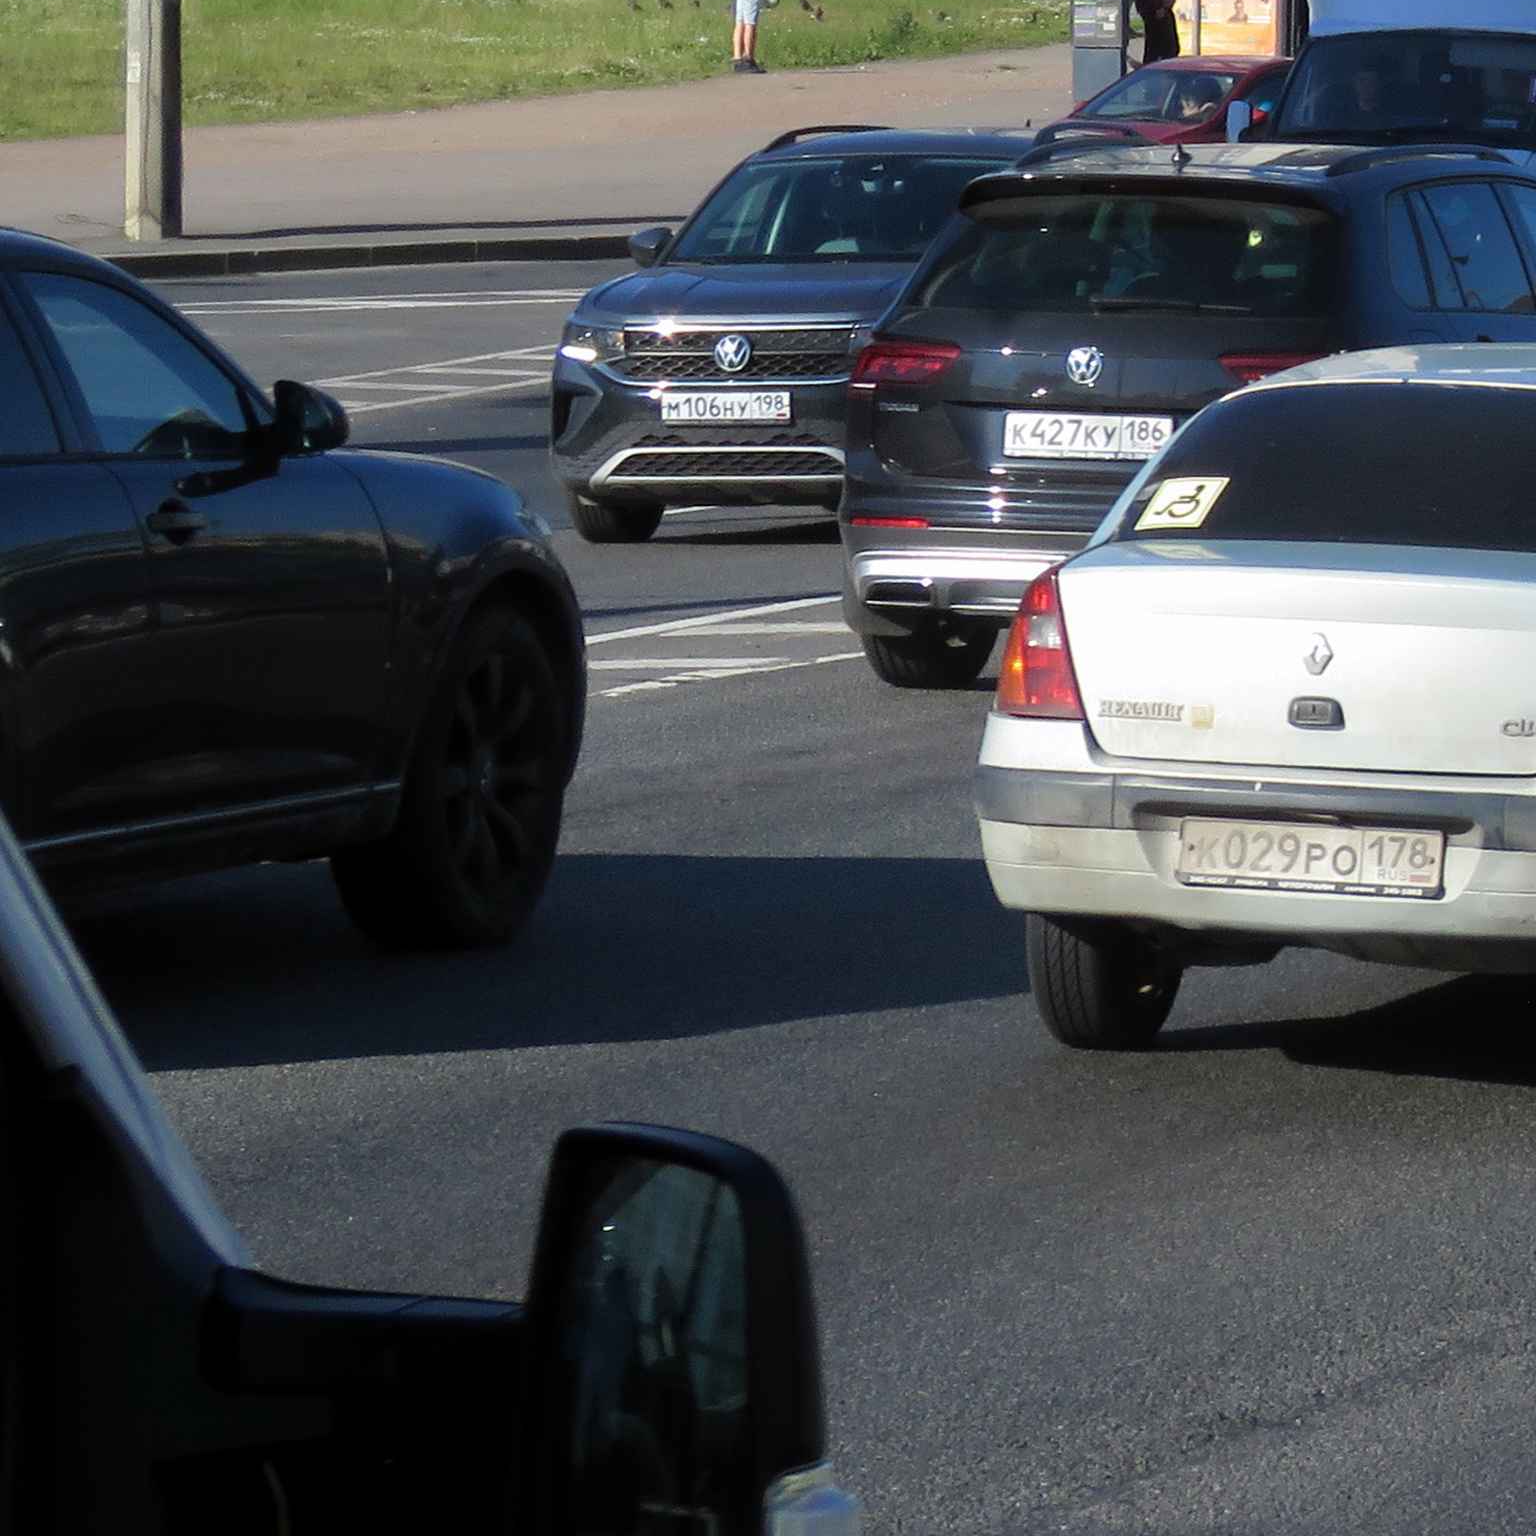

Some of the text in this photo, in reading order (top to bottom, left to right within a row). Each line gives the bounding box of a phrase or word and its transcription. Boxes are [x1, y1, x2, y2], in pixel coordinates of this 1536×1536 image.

[667, 395, 784, 417] М106НУ 198
[1012, 418, 1164, 447] К427КУ 186
[1098, 698, 1184, 721] RENAULT
[1199, 830, 1429, 877] К029РО 178
[1377, 866, 1409, 882] RUS
